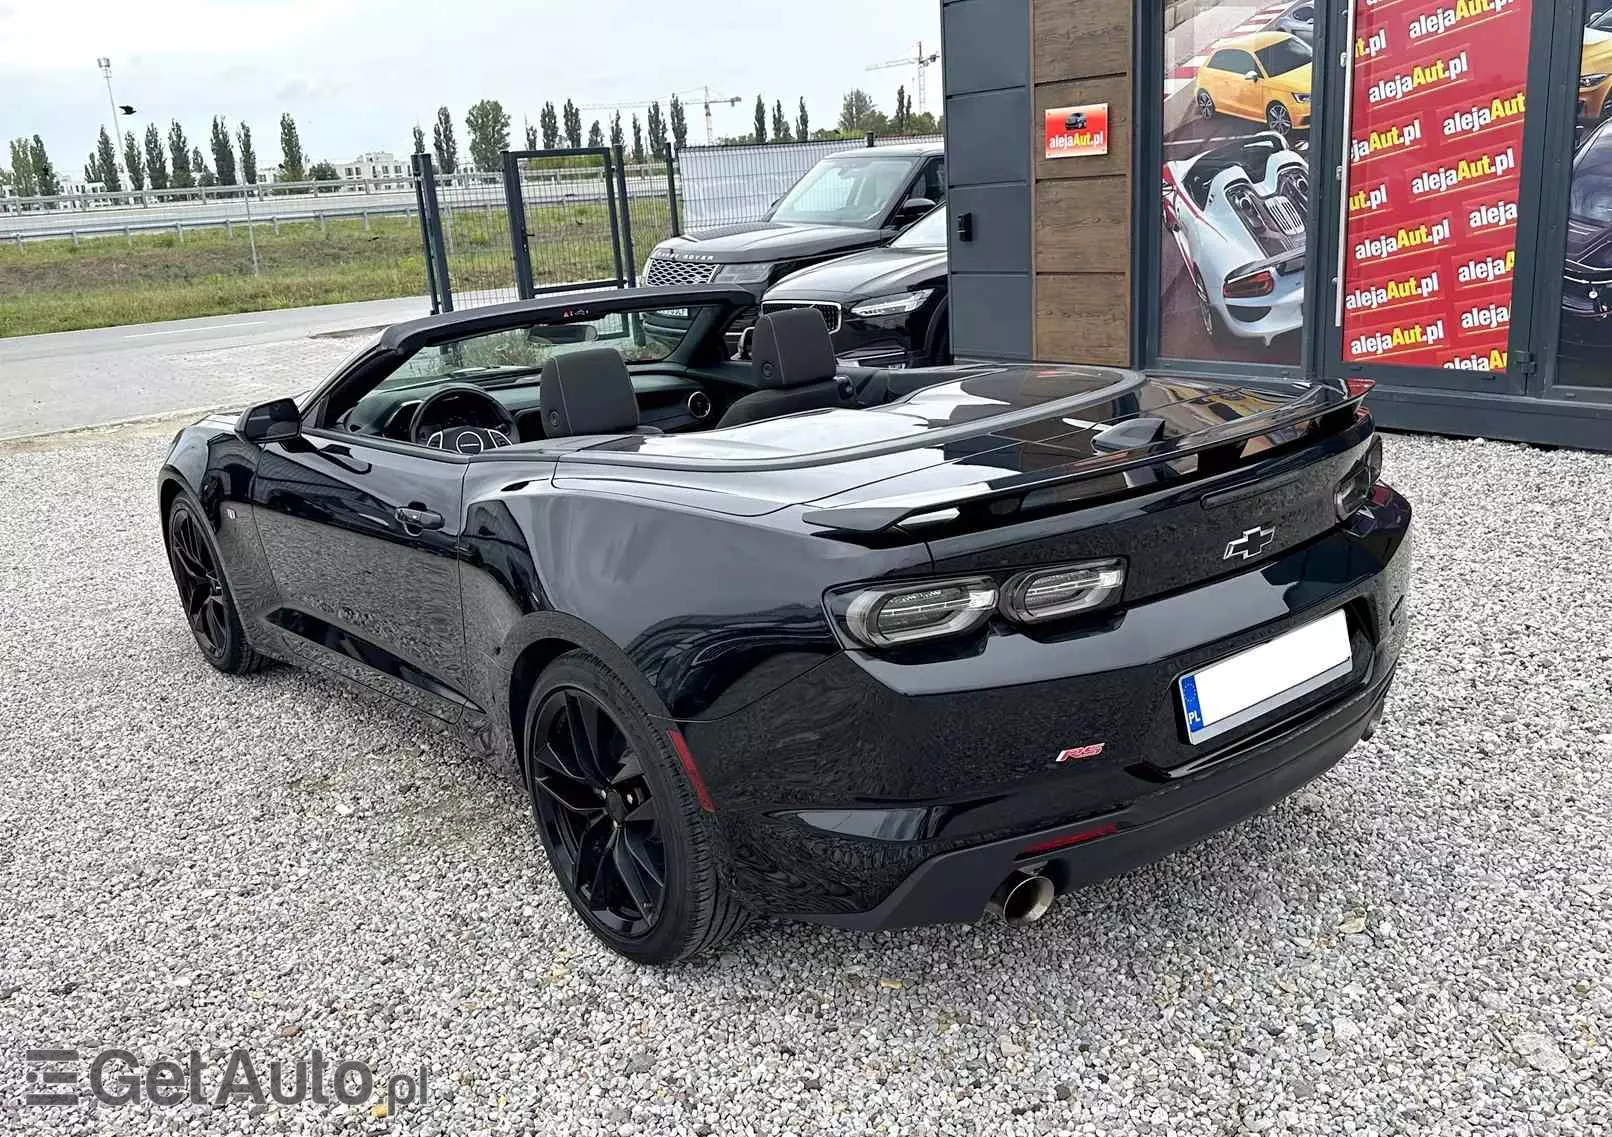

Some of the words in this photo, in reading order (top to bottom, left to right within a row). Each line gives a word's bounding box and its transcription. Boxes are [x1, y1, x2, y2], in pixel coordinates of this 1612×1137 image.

[1409, 0, 1514, 39] alejaAut.p
[1368, 52, 1468, 103] alejaAut.pl
[1442, 92, 1526, 135] alejaAut
[1048, 131, 1104, 150] alejaAut.pl
[1411, 148, 1516, 194] alejaAut.pl
[1469, 202, 1518, 228] aleja
[1354, 219, 1450, 260] alejaAut.pl
[1345, 272, 1440, 309] alejaAut.pl
[1350, 320, 1445, 355] alejaAut.pl
[1188, 710, 1201, 725] PL
[1056, 743, 1105, 762] RS
